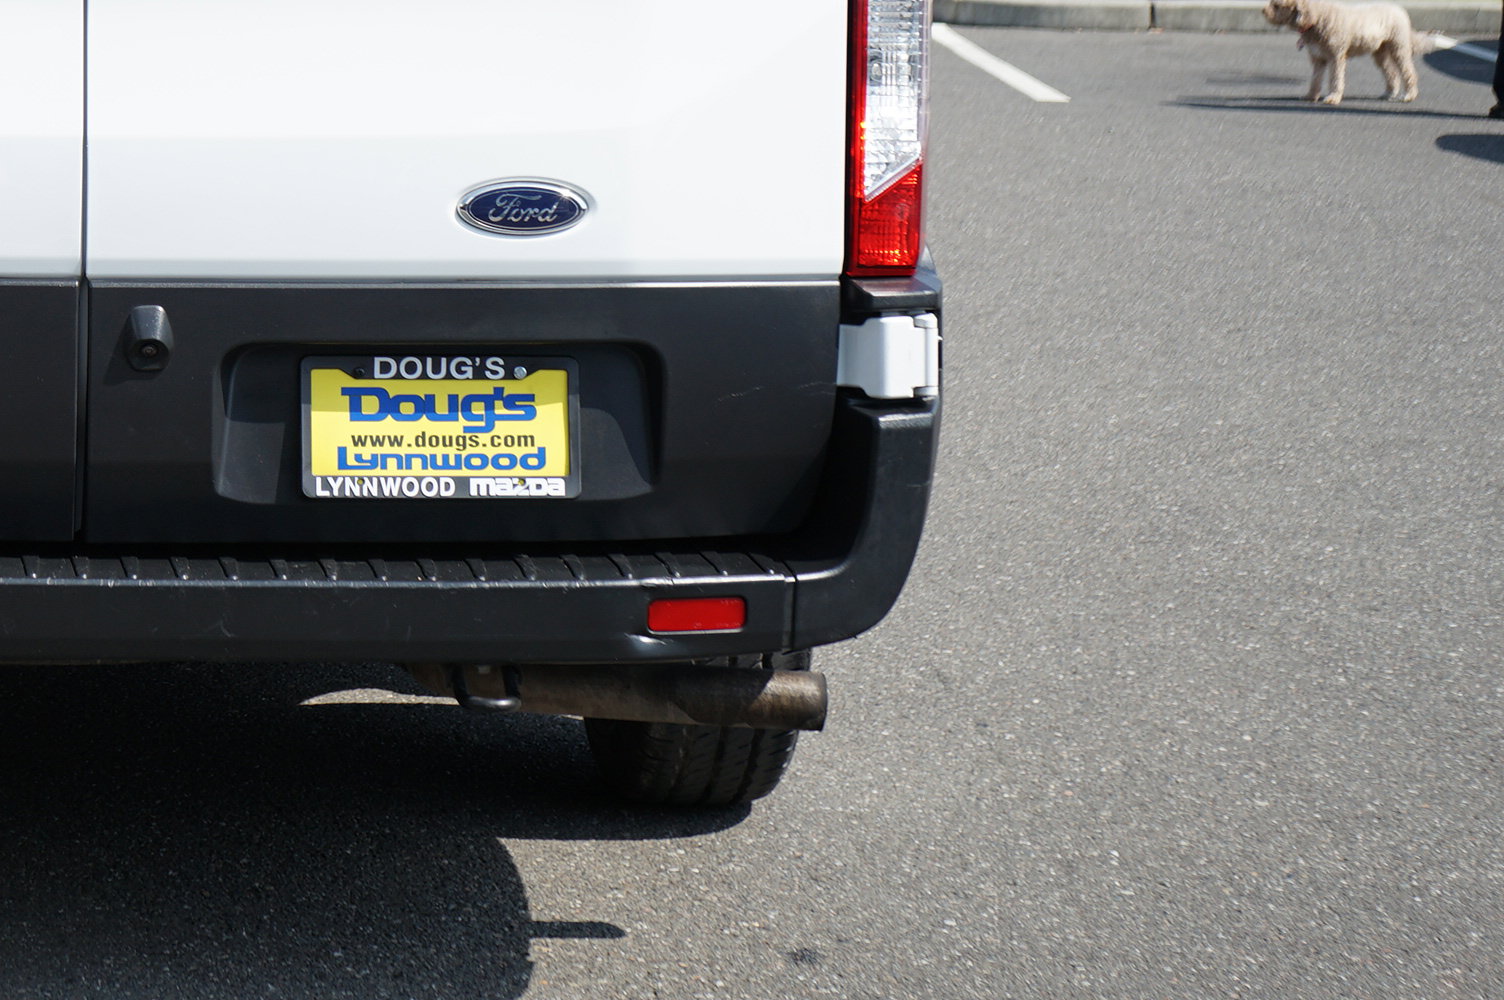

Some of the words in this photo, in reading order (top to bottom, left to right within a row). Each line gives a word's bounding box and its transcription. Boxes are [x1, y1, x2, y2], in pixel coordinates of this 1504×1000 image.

[488, 193, 559, 222] Ford
[373, 356, 506, 380] DOUG'S
[341, 386, 537, 433] Doug's
[351, 431, 535, 451] www.dougs.com
[337, 446, 546, 471] Lynnwood
[315, 477, 455, 497] LYNNWOOD
